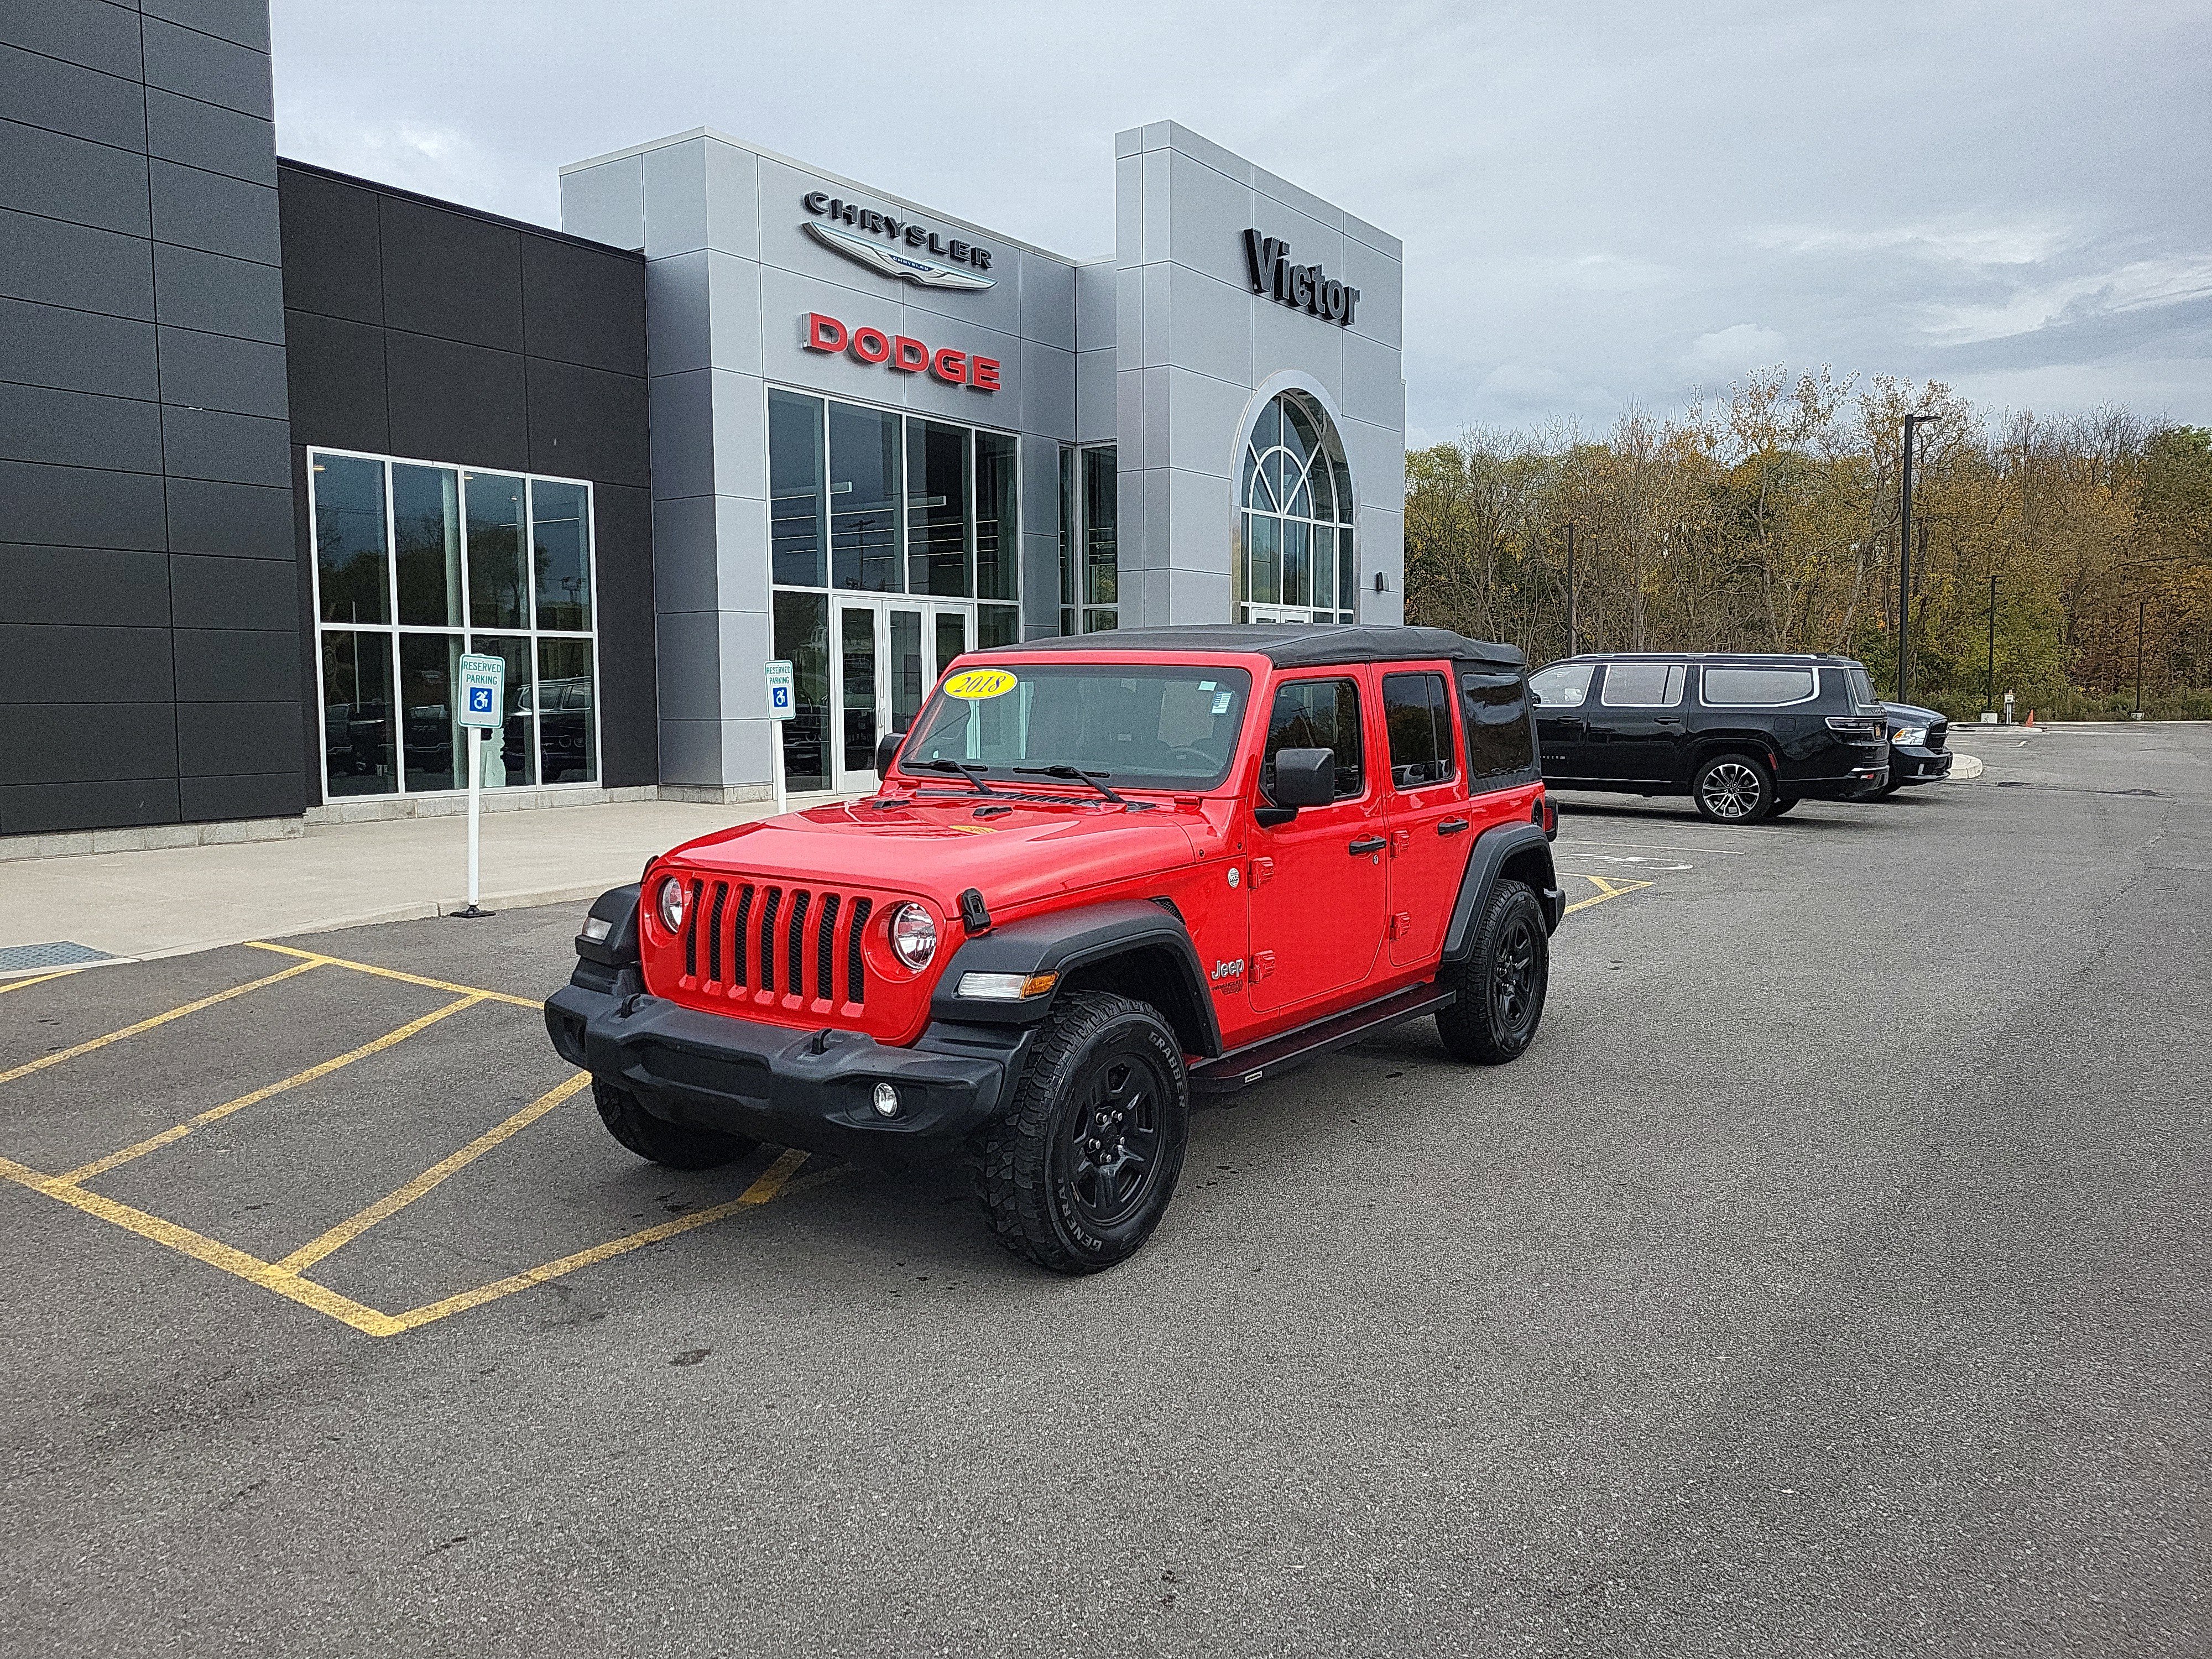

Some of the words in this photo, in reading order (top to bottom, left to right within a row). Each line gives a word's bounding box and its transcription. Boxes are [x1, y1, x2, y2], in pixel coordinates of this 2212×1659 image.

[804, 191, 993, 268] CHRYSLER
[1244, 228, 1361, 325] Victor
[803, 311, 1001, 391] DODGE
[463, 661, 502, 672] RESERVED
[466, 674, 498, 685] PARKING
[769, 676, 790, 685] PARKING
[952, 675, 1006, 692] 2018
[1211, 959, 1244, 979] Jeep
[1148, 1031, 1185, 1107] GRABBER
[1058, 1173, 1102, 1251] GENERAL
